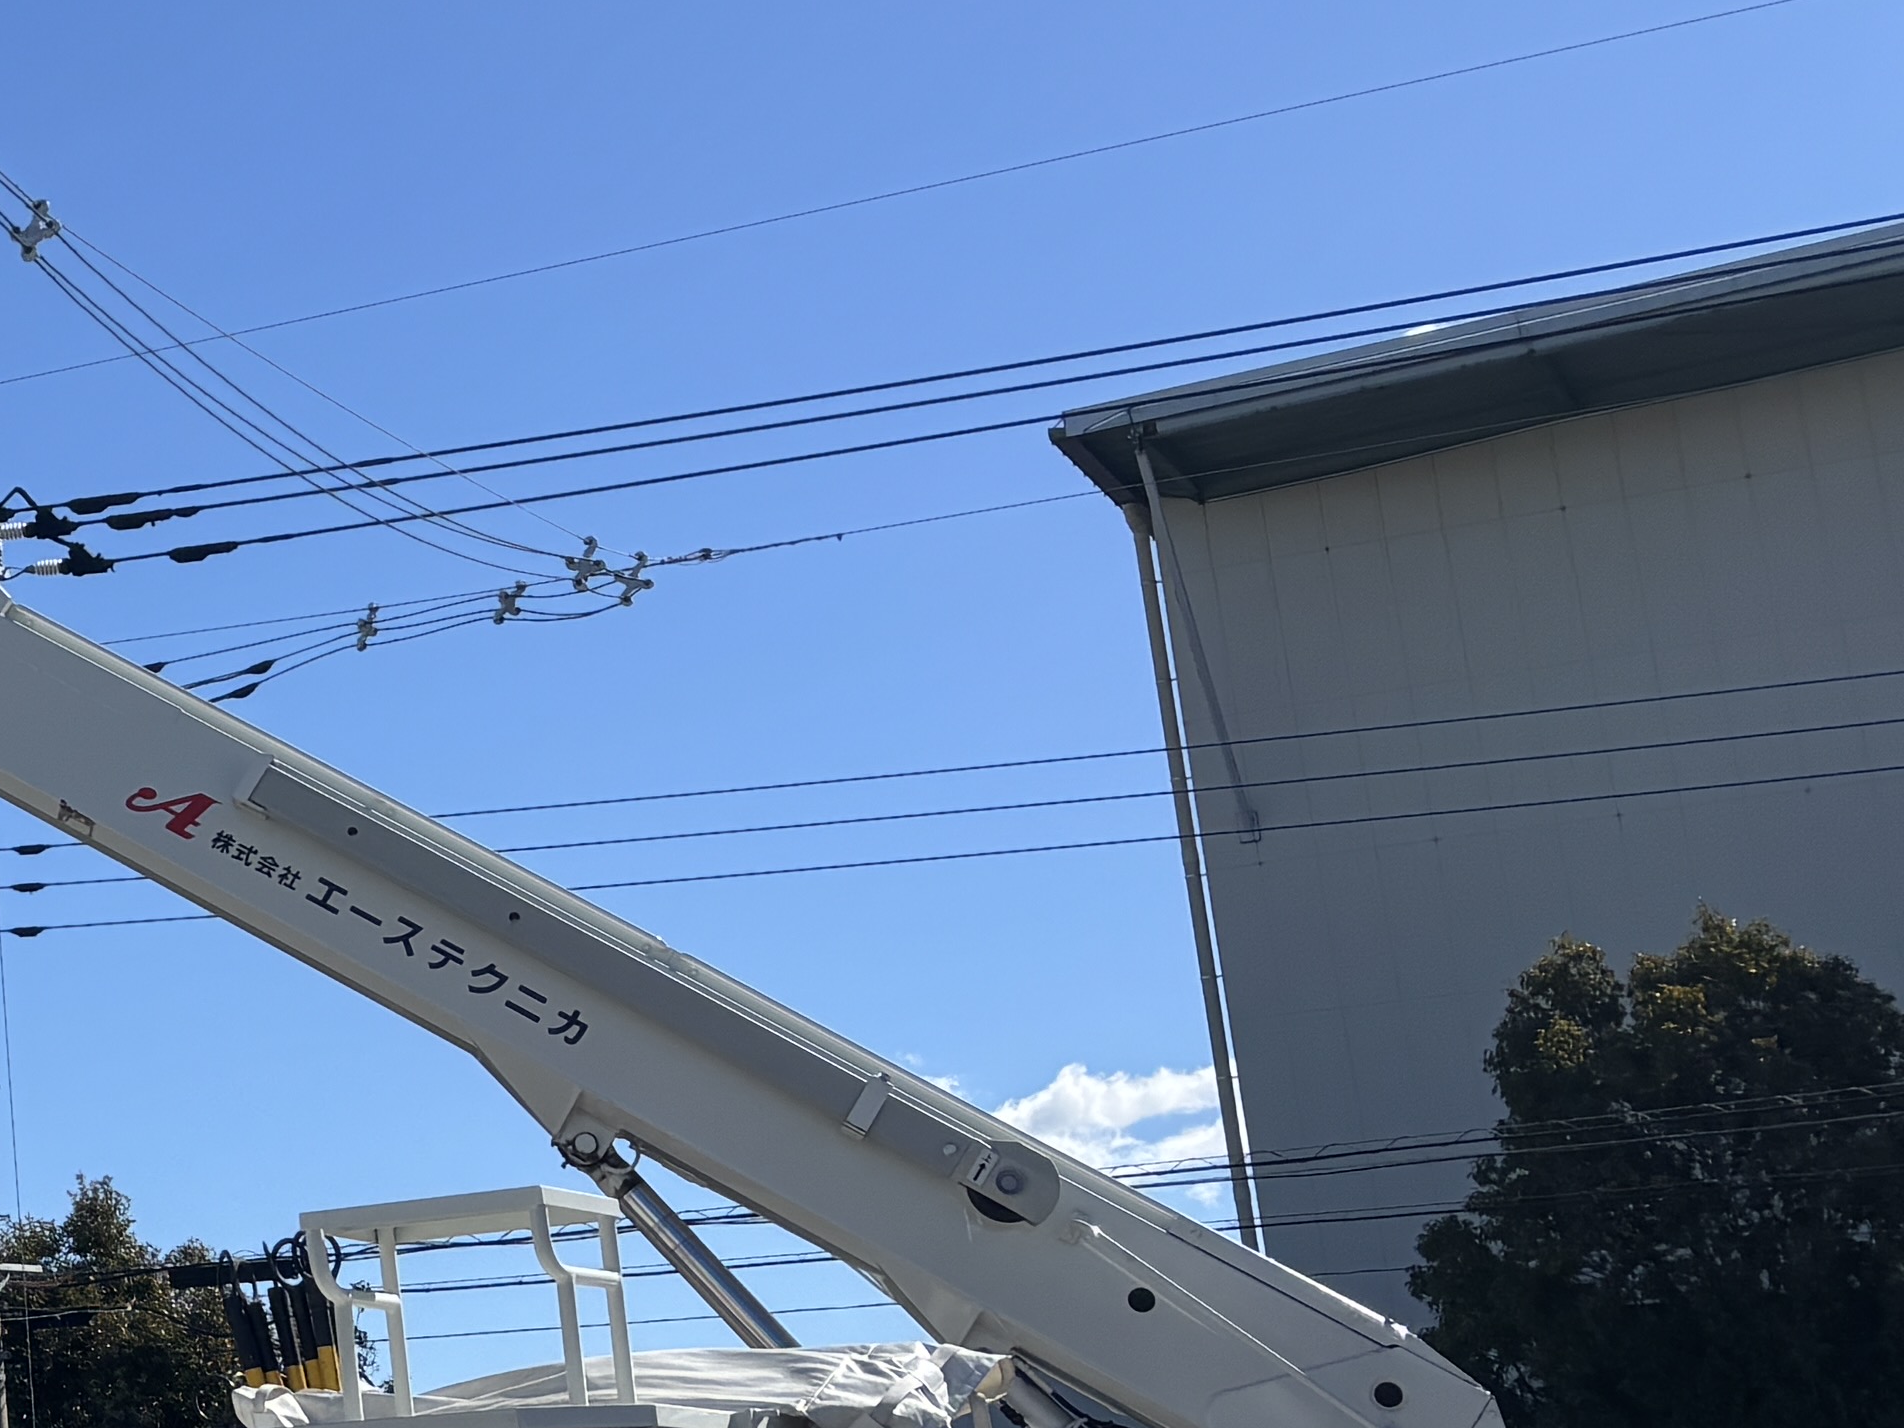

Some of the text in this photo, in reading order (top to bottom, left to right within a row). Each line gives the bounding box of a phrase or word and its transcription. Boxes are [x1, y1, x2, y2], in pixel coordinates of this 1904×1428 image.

[211, 829, 589, 1045] 株式会社 エーステクニカ
